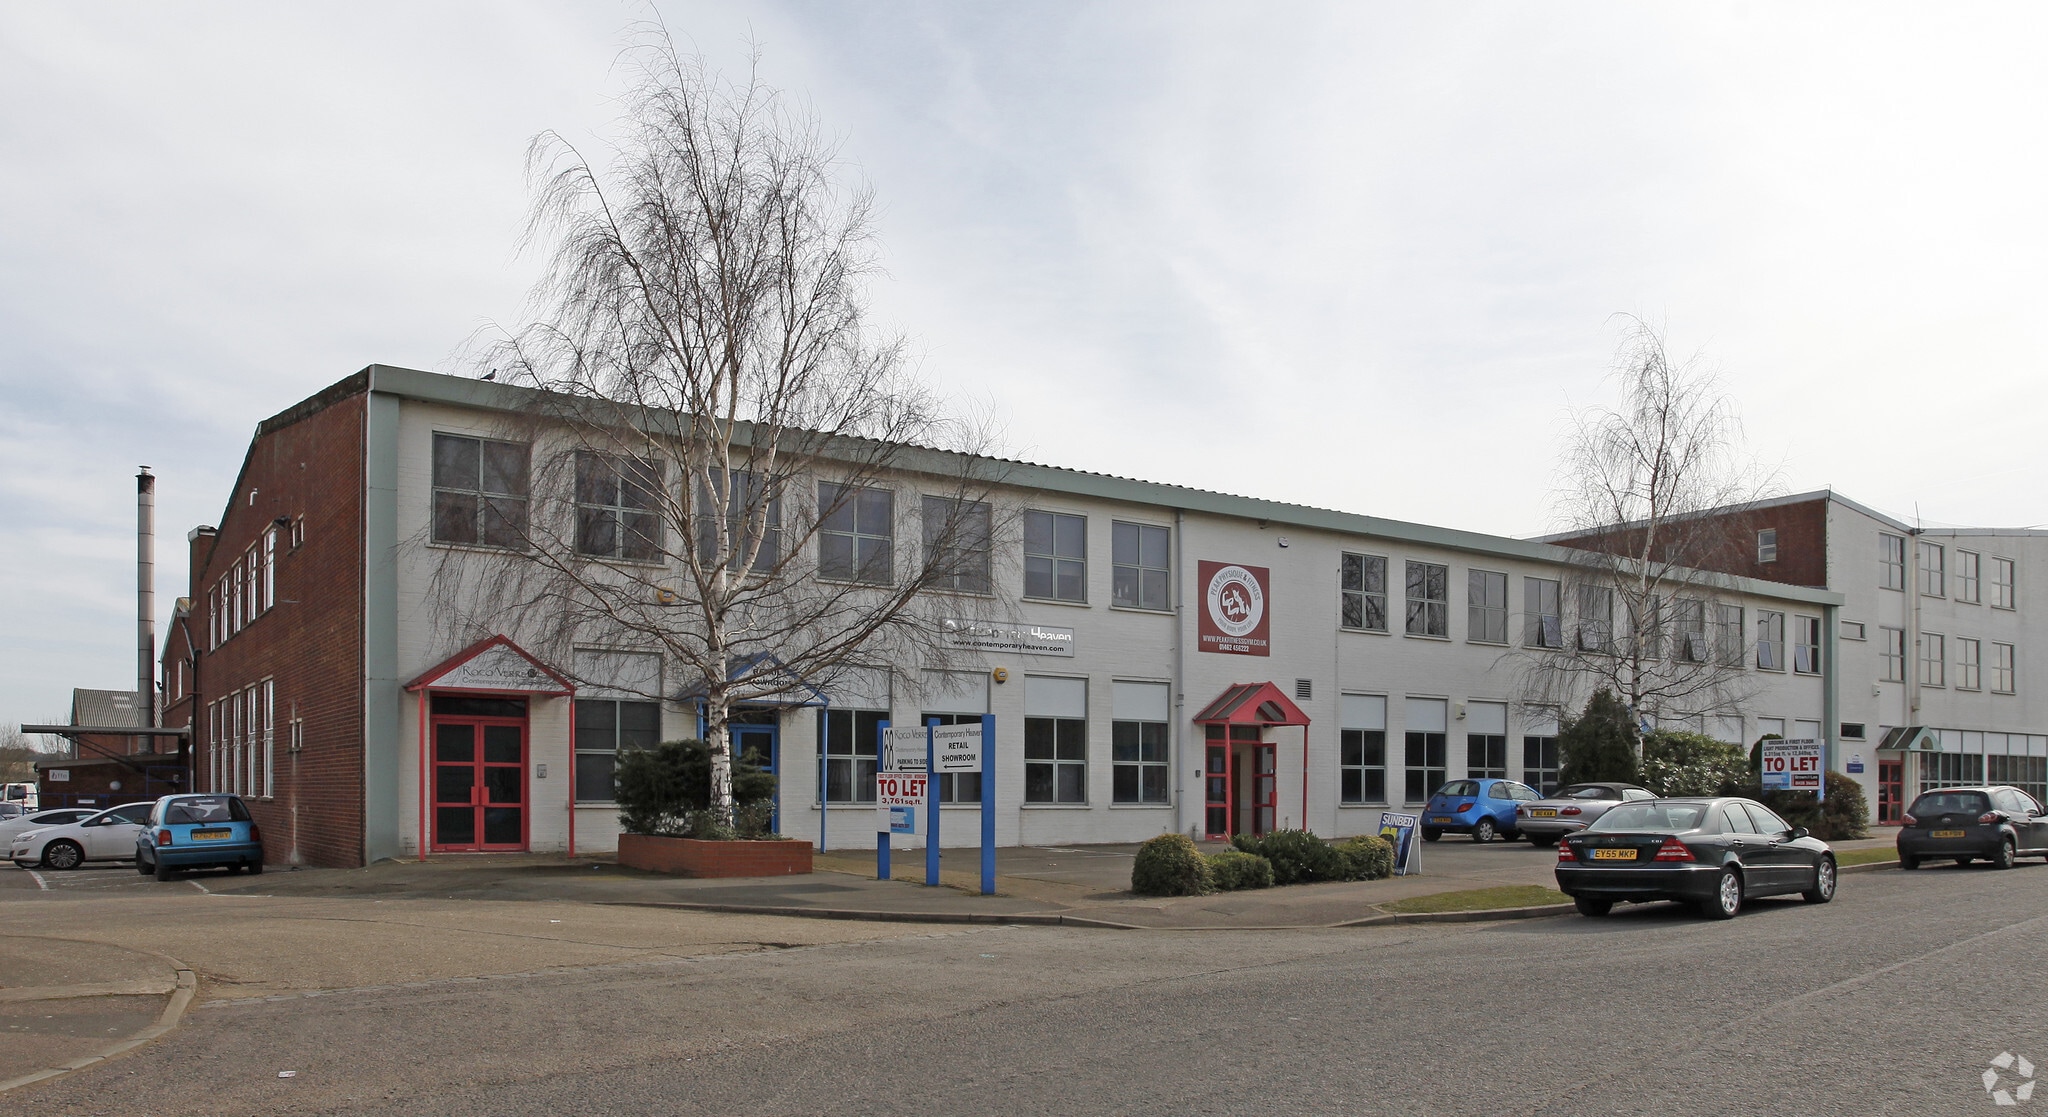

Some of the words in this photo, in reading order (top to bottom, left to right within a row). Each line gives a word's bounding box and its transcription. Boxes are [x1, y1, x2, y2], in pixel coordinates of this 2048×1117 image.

[1211, 579, 1221, 596] PEAK
[1218, 569, 1244, 582] PHYSIQUE
[1247, 577, 1261, 600] FITNESS
[953, 639, 1065, 652] www.contemporaryheaven.com
[934, 730, 965, 739] Contemporary
[884, 730, 894, 770] 68
[948, 742, 969, 750] RETAIL
[941, 754, 976, 763] SHOWROOM
[1764, 757, 1785, 771] TO
[1790, 757, 1819, 771] LET
[878, 779, 898, 796] TO
[902, 779, 926, 797] LET
[1382, 814, 1414, 827] SUNBED
[1594, 850, 1617, 858] EY55
[1618, 850, 1636, 858] MKP
